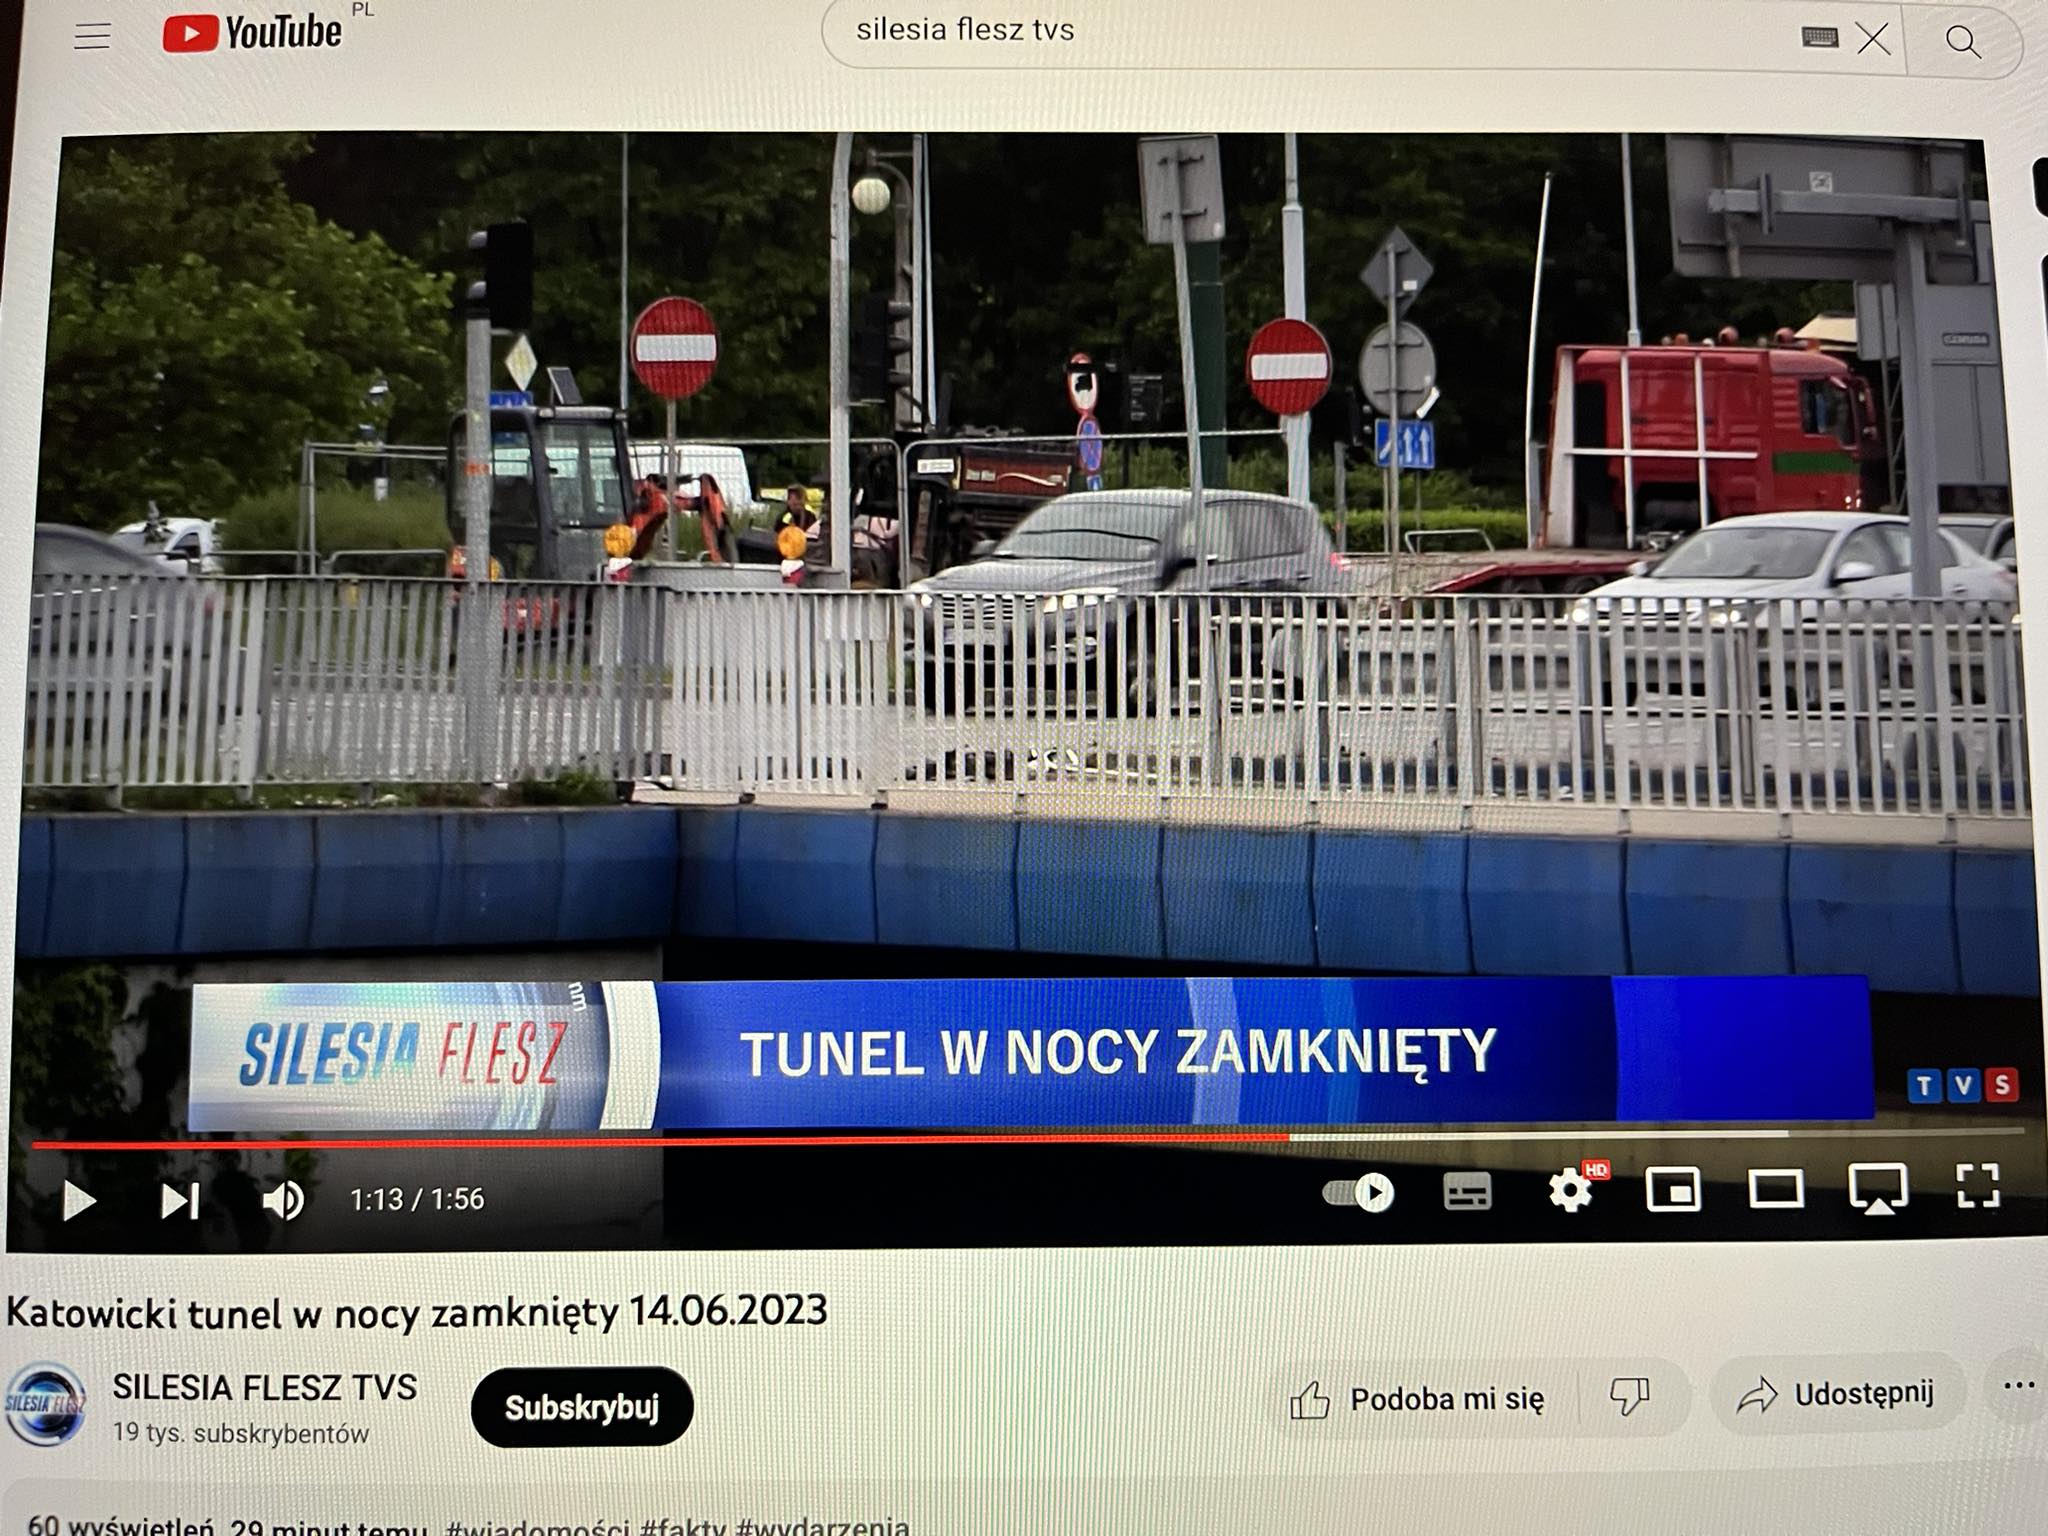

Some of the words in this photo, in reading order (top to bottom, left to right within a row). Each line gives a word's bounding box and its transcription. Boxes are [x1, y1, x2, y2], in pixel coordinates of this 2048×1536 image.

[351, 1, 375, 17] PL
[226, 12, 342, 49] YouTube
[856, 16, 947, 41] silesia
[957, 16, 1024, 41] flesz
[1032, 18, 1075, 41] tvs
[239, 1021, 421, 1087] SILESIA
[438, 1020, 569, 1085] FLESZ
[740, 1032, 925, 1077] TUNEL
[941, 1030, 988, 1074] W
[1008, 1029, 1158, 1074] NOCY
[1177, 1028, 1497, 1084] ZAMKNIĘTY
[1585, 1163, 1609, 1177] HD
[351, 1187, 404, 1211] 1:13
[410, 1187, 424, 1212] /
[431, 1186, 485, 1211] 1:56
[6, 1294, 178, 1330] Katowicki
[187, 1297, 282, 1331] tunel
[292, 1306, 323, 1329] w
[335, 1305, 421, 1337] nocy
[431, 1294, 620, 1335] zamknięty
[630, 1293, 828, 1327] 14.06.2023
[113, 1372, 233, 1401] SILESIA
[243, 1373, 342, 1402] FLESZ
[351, 1373, 417, 1401] TVS
[1351, 1385, 1455, 1412] Podoba
[1464, 1385, 1496, 1411] mi
[1505, 1385, 1545, 1416] się
[1795, 1378, 1934, 1410] Udostępnij
[5, 1394, 50, 1412] SILESIA
[505, 1392, 659, 1427] Subskrybuj
[113, 1420, 140, 1442] 19
[145, 1422, 186, 1448] tys.
[193, 1422, 370, 1450] subskrybentów
[27, 1515, 60, 1536] 60
[67, 1516, 215, 1536] wyświetleń
[230, 1520, 264, 1536] 29
[271, 1521, 351, 1536] minut
[357, 1523, 428, 1536] temu
[446, 1520, 629, 1536] #wiadomości
[640, 1518, 727, 1536] #fakty
[736, 1517, 911, 1536] #wydarzenia
